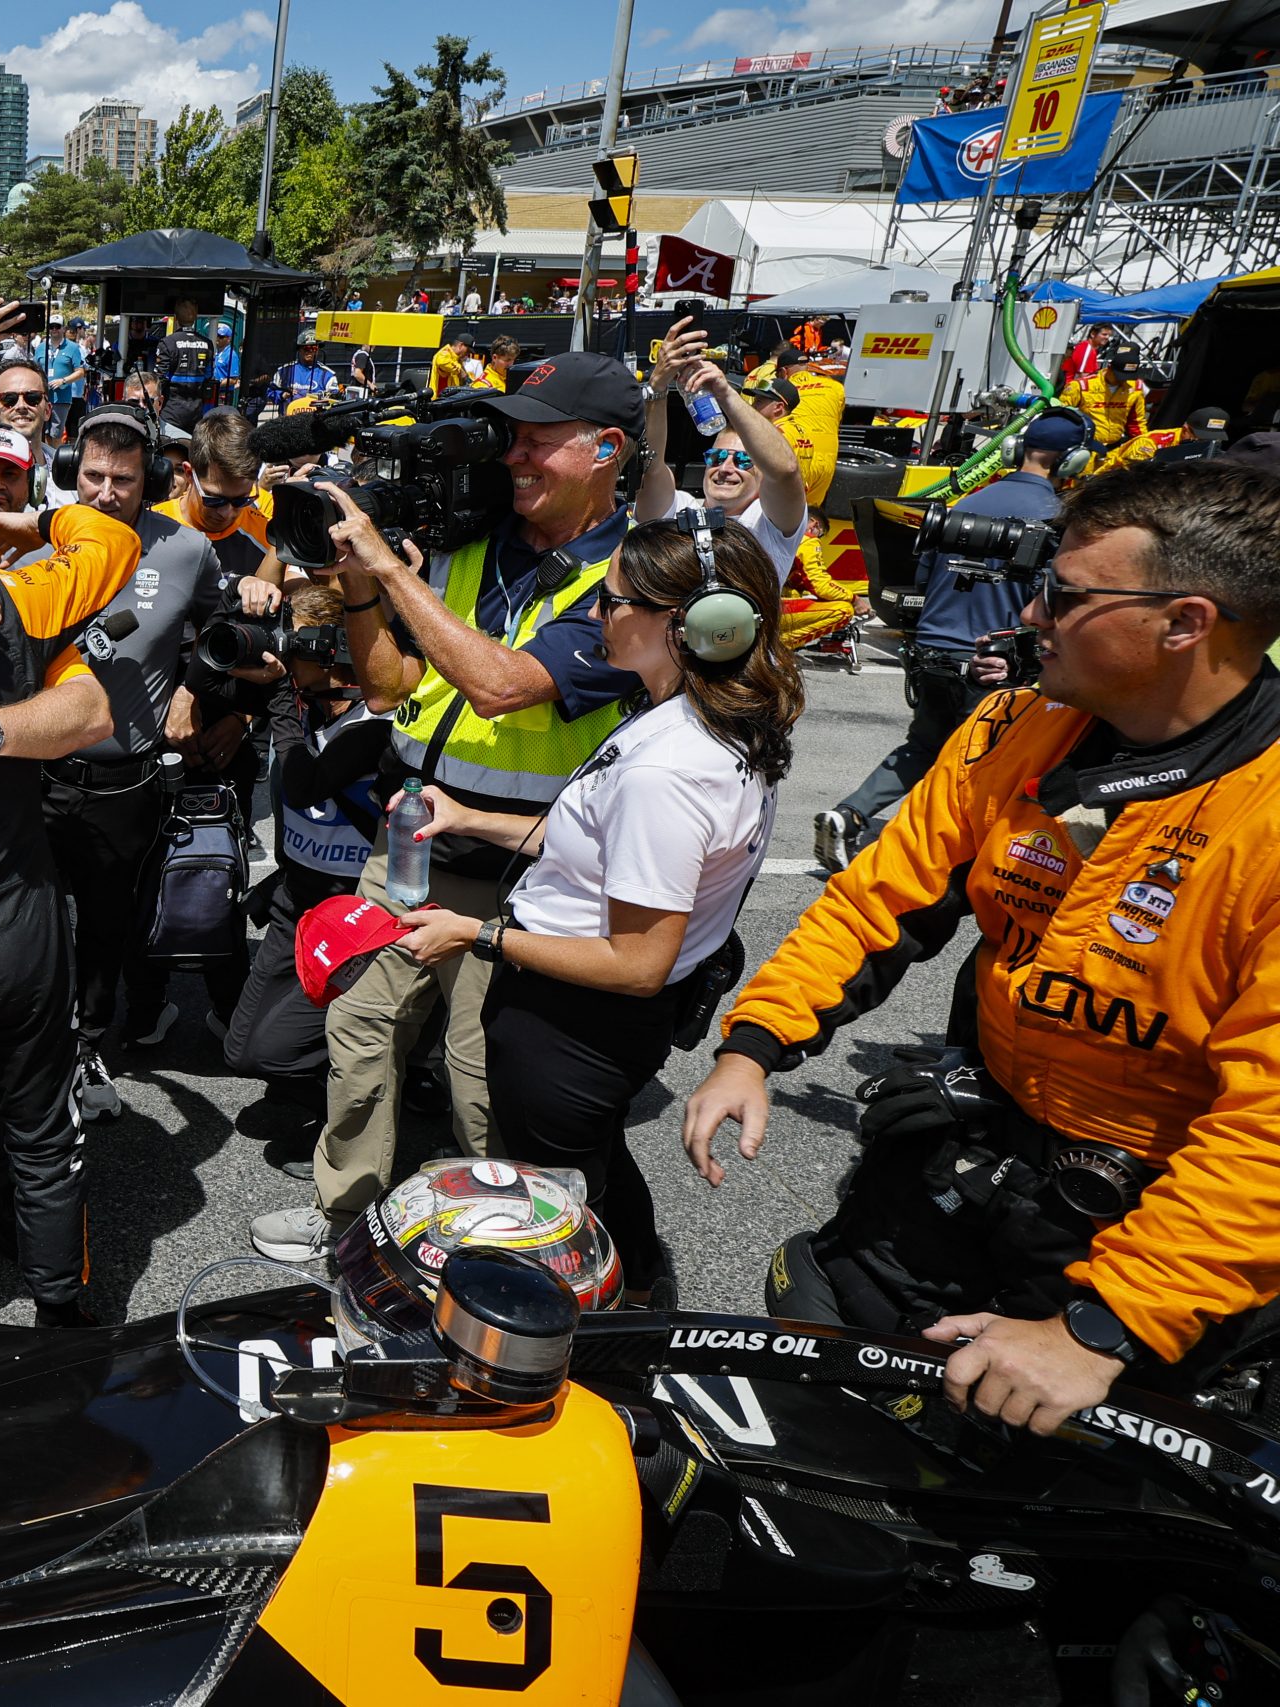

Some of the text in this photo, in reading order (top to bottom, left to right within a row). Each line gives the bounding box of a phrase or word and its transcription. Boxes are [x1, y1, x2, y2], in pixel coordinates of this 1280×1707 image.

[1044, 42, 1077, 60] DHL
[749, 55, 794, 73] TRIUMPH
[1034, 65, 1076, 80] RACING
[1043, 55, 1078, 72] GANASSI
[1029, 90, 1060, 134] 10
[870, 336, 923, 355] DHL
[137, 601, 154, 610] FOX
[92, 632, 109, 653] FOX
[1097, 766, 1187, 795] arrow.com
[992, 866, 1041, 892] LUCAS
[1115, 901, 1164, 928] INDYCAR
[313, 940, 332, 967] 1ST
[1088, 943, 1116, 960] CHRIS
[380, 1198, 401, 1238] ectrolit
[419, 1243, 445, 1267] KitKa
[669, 1328, 821, 1359] LUCAS OIL
[890, 1355, 936, 1377] NTT
[413, 1482, 553, 1693] 5
